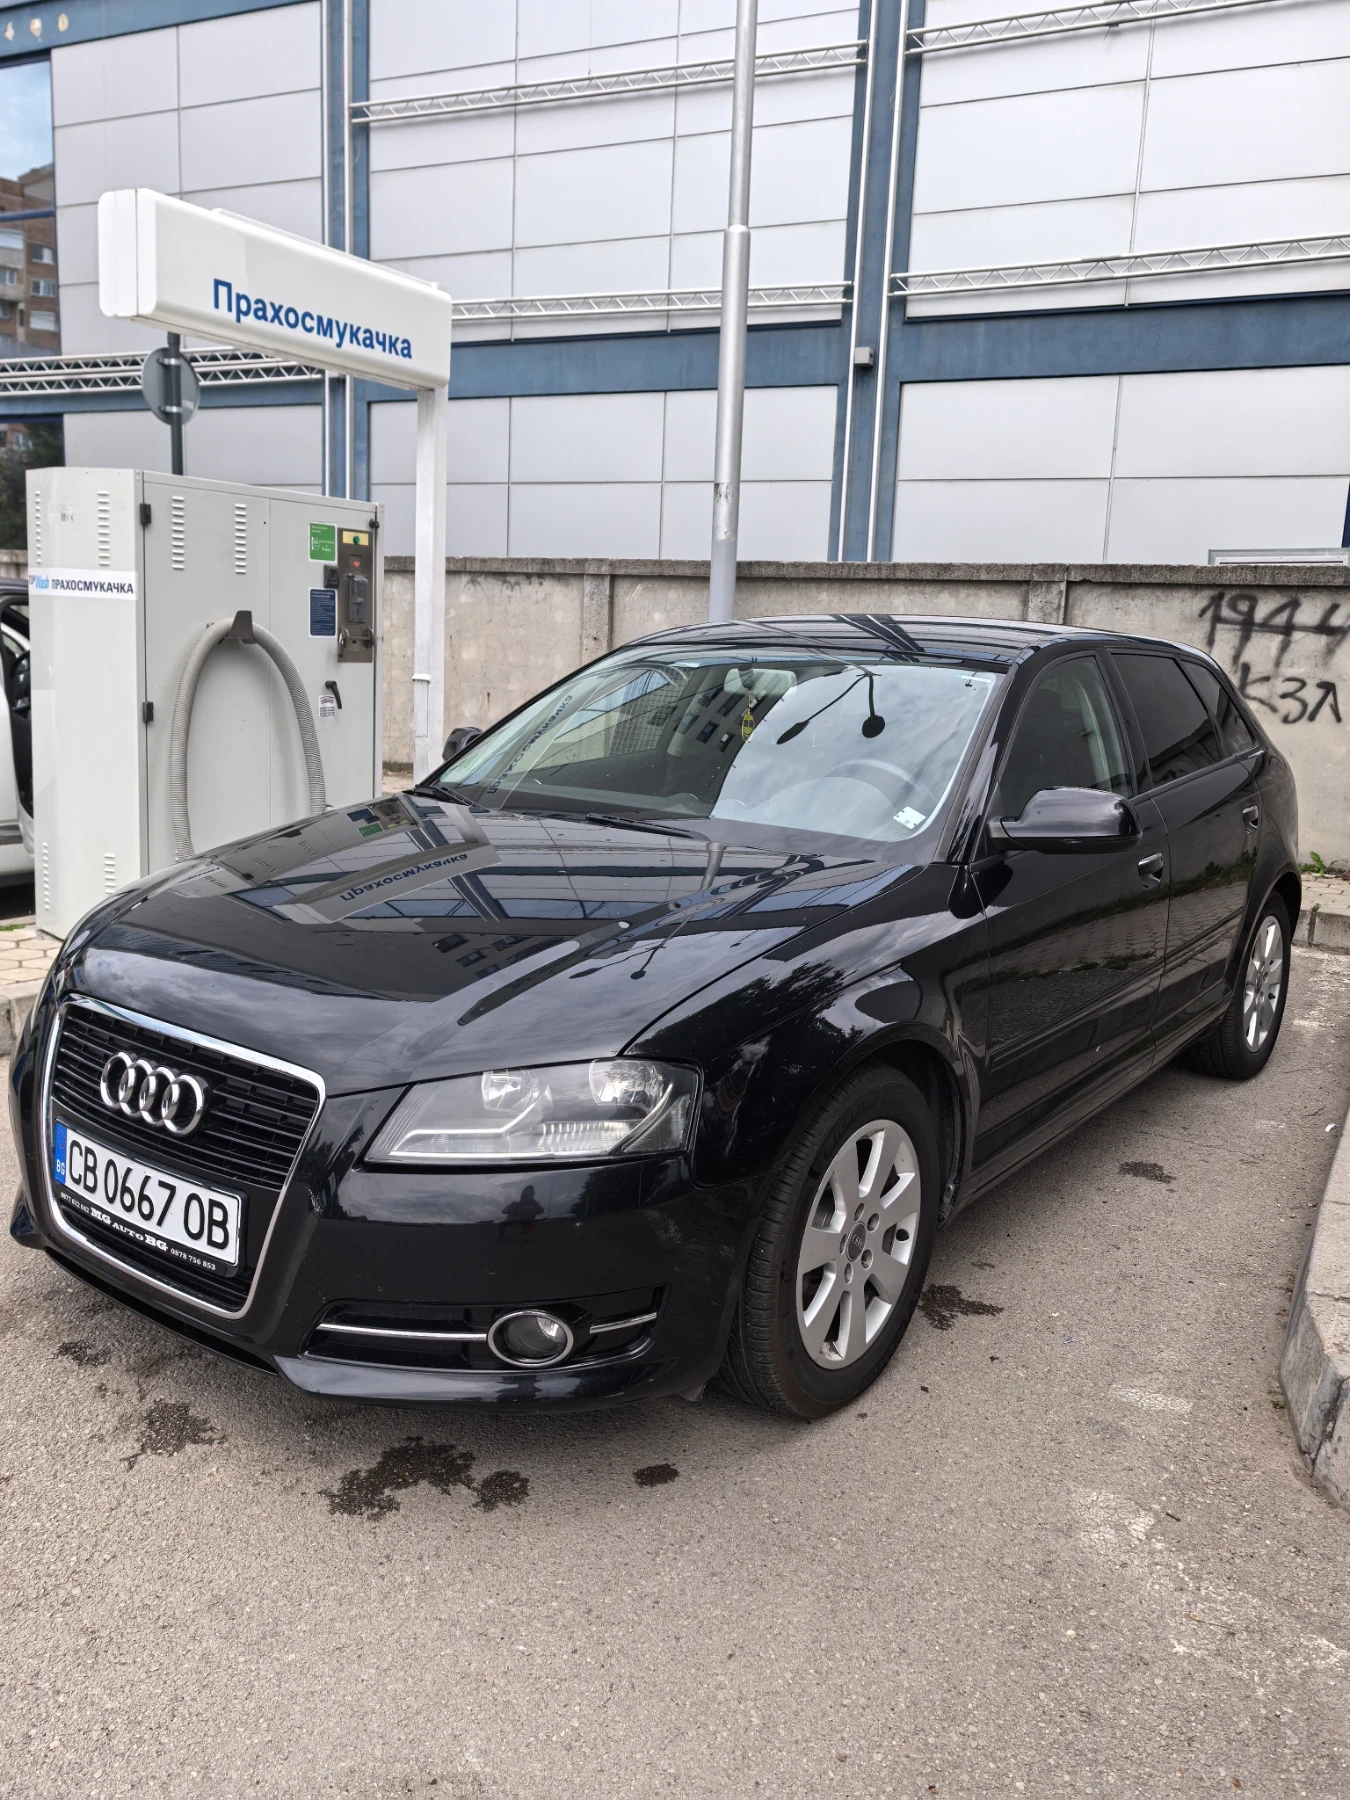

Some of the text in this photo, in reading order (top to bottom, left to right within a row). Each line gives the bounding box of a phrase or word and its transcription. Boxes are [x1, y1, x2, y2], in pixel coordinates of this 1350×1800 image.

[213, 278, 412, 359] Прахосмукачка
[51, 579, 134, 594] ПРАХОСМУКАЧКА
[56, 1158, 66, 1176] BG
[69, 1139, 230, 1250] CB 0667 OB
[90, 1206, 112, 1226] MG
[170, 1247, 187, 1260] 0878
[188, 1254, 201, 1266] 756
[202, 1260, 216, 1271] 853
